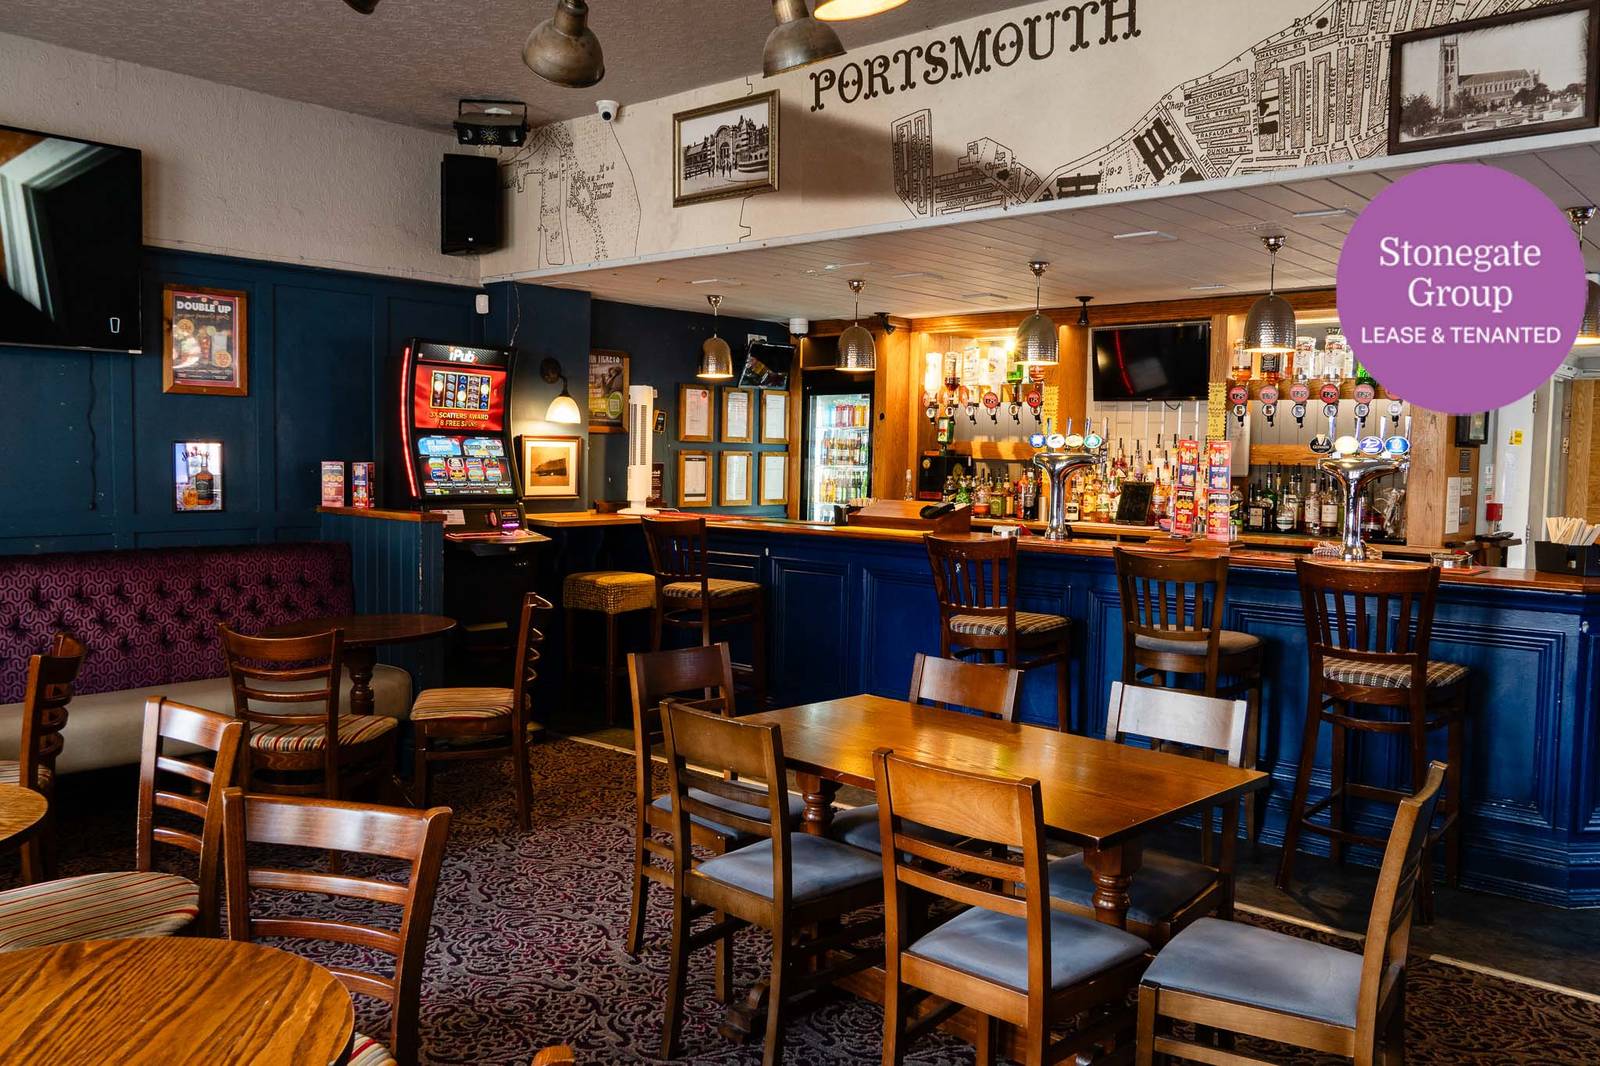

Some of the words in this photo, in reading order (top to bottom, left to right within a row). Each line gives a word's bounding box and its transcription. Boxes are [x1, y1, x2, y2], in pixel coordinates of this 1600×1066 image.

[810, 0, 1142, 112] PORTSMOUTH
[1364, 48, 1373, 90] CLARENCE
[1328, 67, 1337, 98] STREET
[1215, 106, 1241, 116] STREET
[176, 300, 215, 312] DOUBLE
[217, 304, 232, 314] UP
[438, 411, 468, 419] SCATTERS
